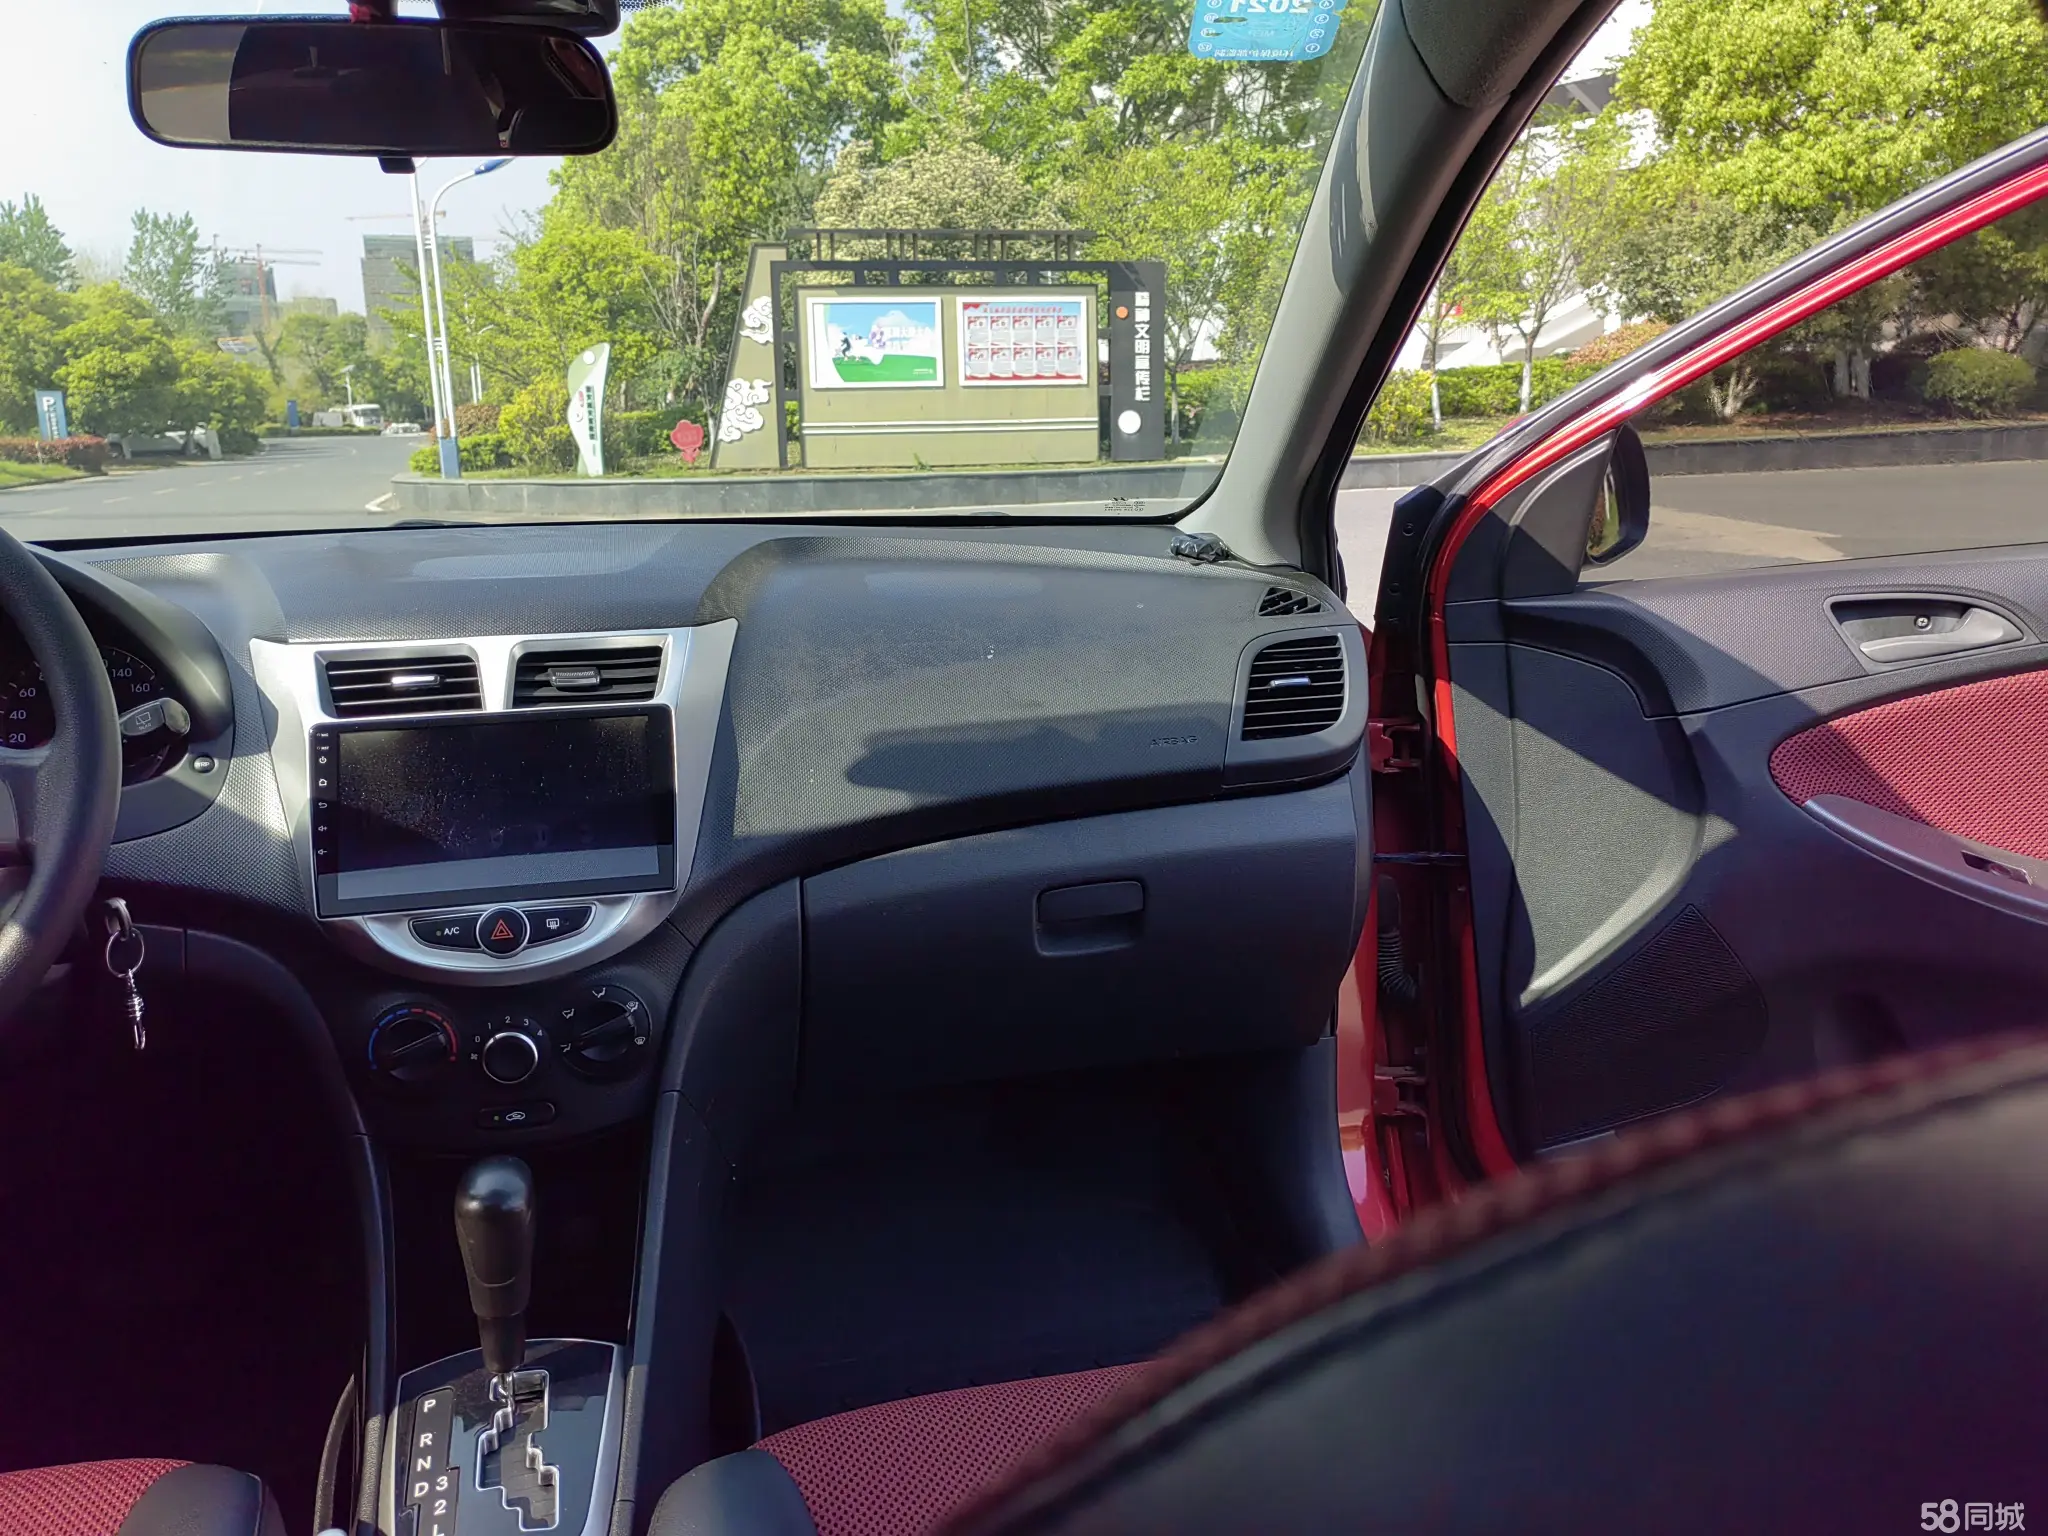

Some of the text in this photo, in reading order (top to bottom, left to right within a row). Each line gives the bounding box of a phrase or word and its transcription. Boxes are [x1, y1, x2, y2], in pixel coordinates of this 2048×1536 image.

[43, 396, 55, 411] P
[112, 668, 132, 677] 140
[19, 687, 36, 698] 60
[131, 683, 150, 693] 160
[9, 709, 26, 720] 40
[9, 732, 26, 743] 20
[1149, 735, 1197, 746] AIRBAG
[443, 926, 460, 936] A/C
[423, 1399, 436, 1413] P
[420, 1433, 432, 1448] R
[416, 1455, 431, 1472] N
[435, 1476, 448, 1491] 3
[414, 1482, 429, 1498] D
[434, 1499, 446, 1516] 2
[433, 1524, 444, 1536] L
